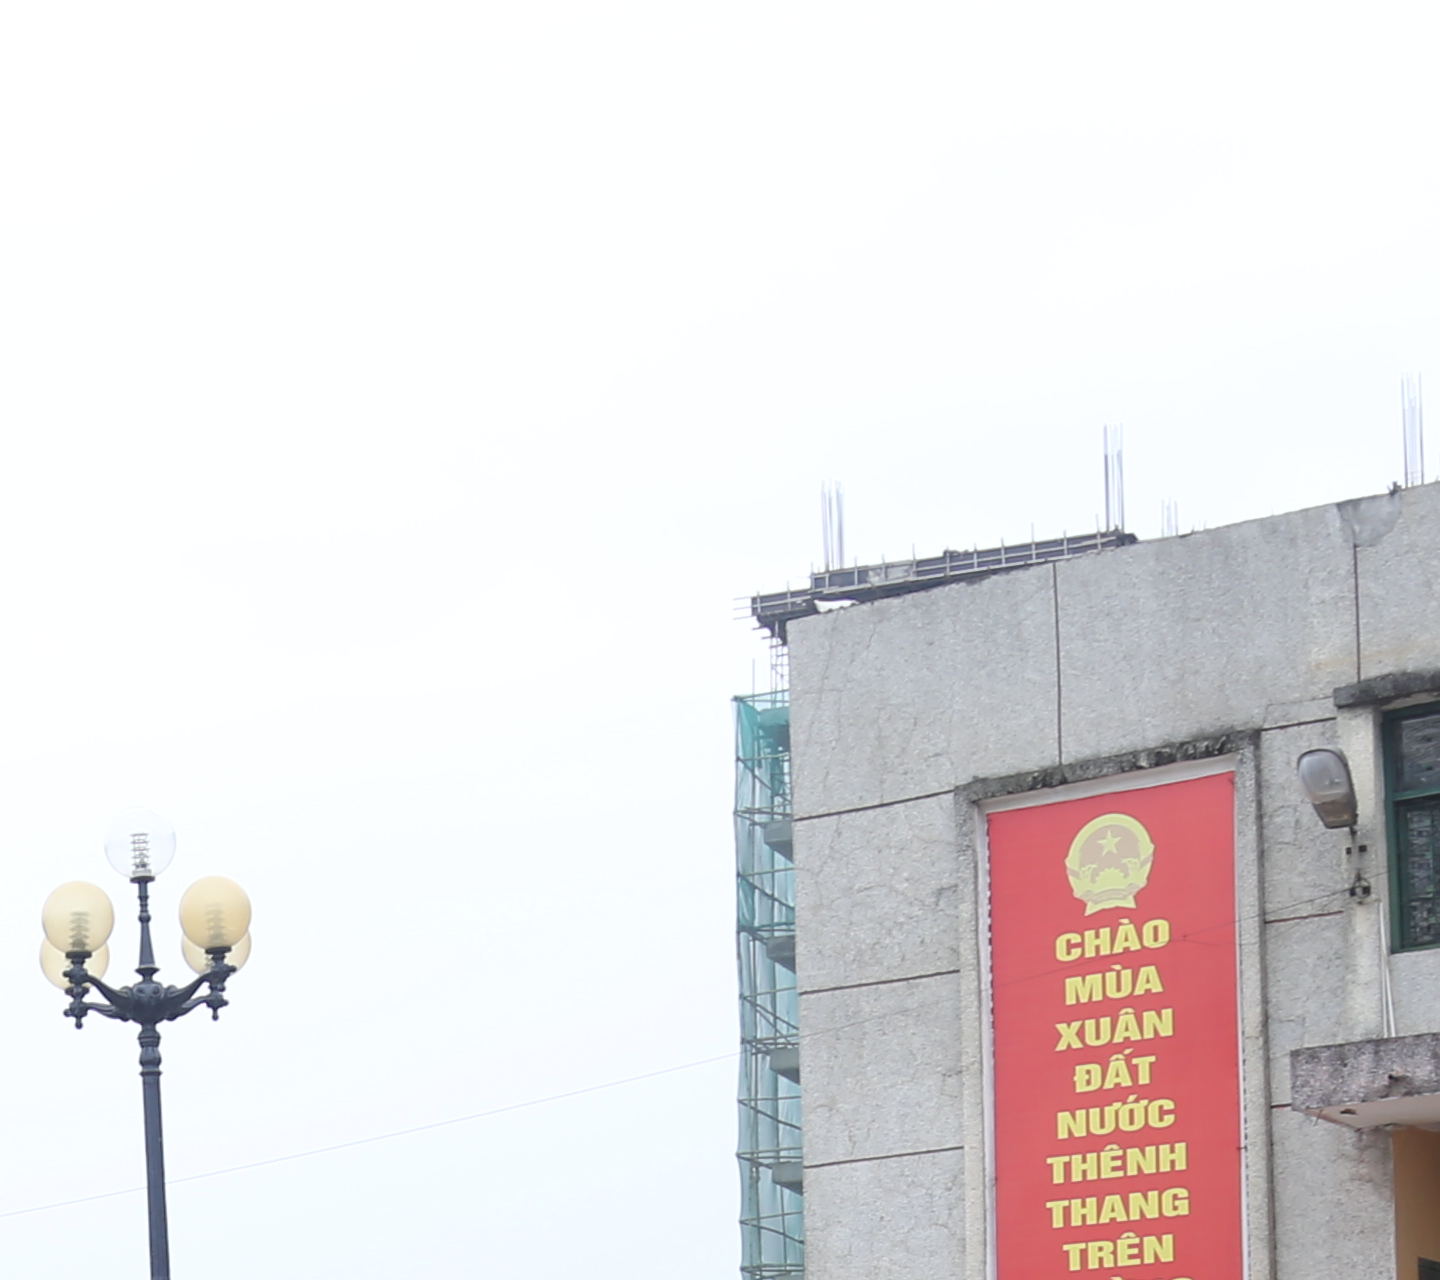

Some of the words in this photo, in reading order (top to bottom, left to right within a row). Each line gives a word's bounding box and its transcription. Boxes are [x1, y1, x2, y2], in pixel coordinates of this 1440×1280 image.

[1055, 919, 1170, 961] CHÀO
[1065, 965, 1163, 1006] MÙA
[1054, 1008, 1173, 1052] XUÂN
[1073, 1048, 1157, 1093] ĐẤT
[1057, 1095, 1175, 1140] NƯỚC
[1046, 1142, 1187, 1184] THÊNH
[1046, 1187, 1189, 1229] THANG
[1063, 1232, 1174, 1272] TRÊN
